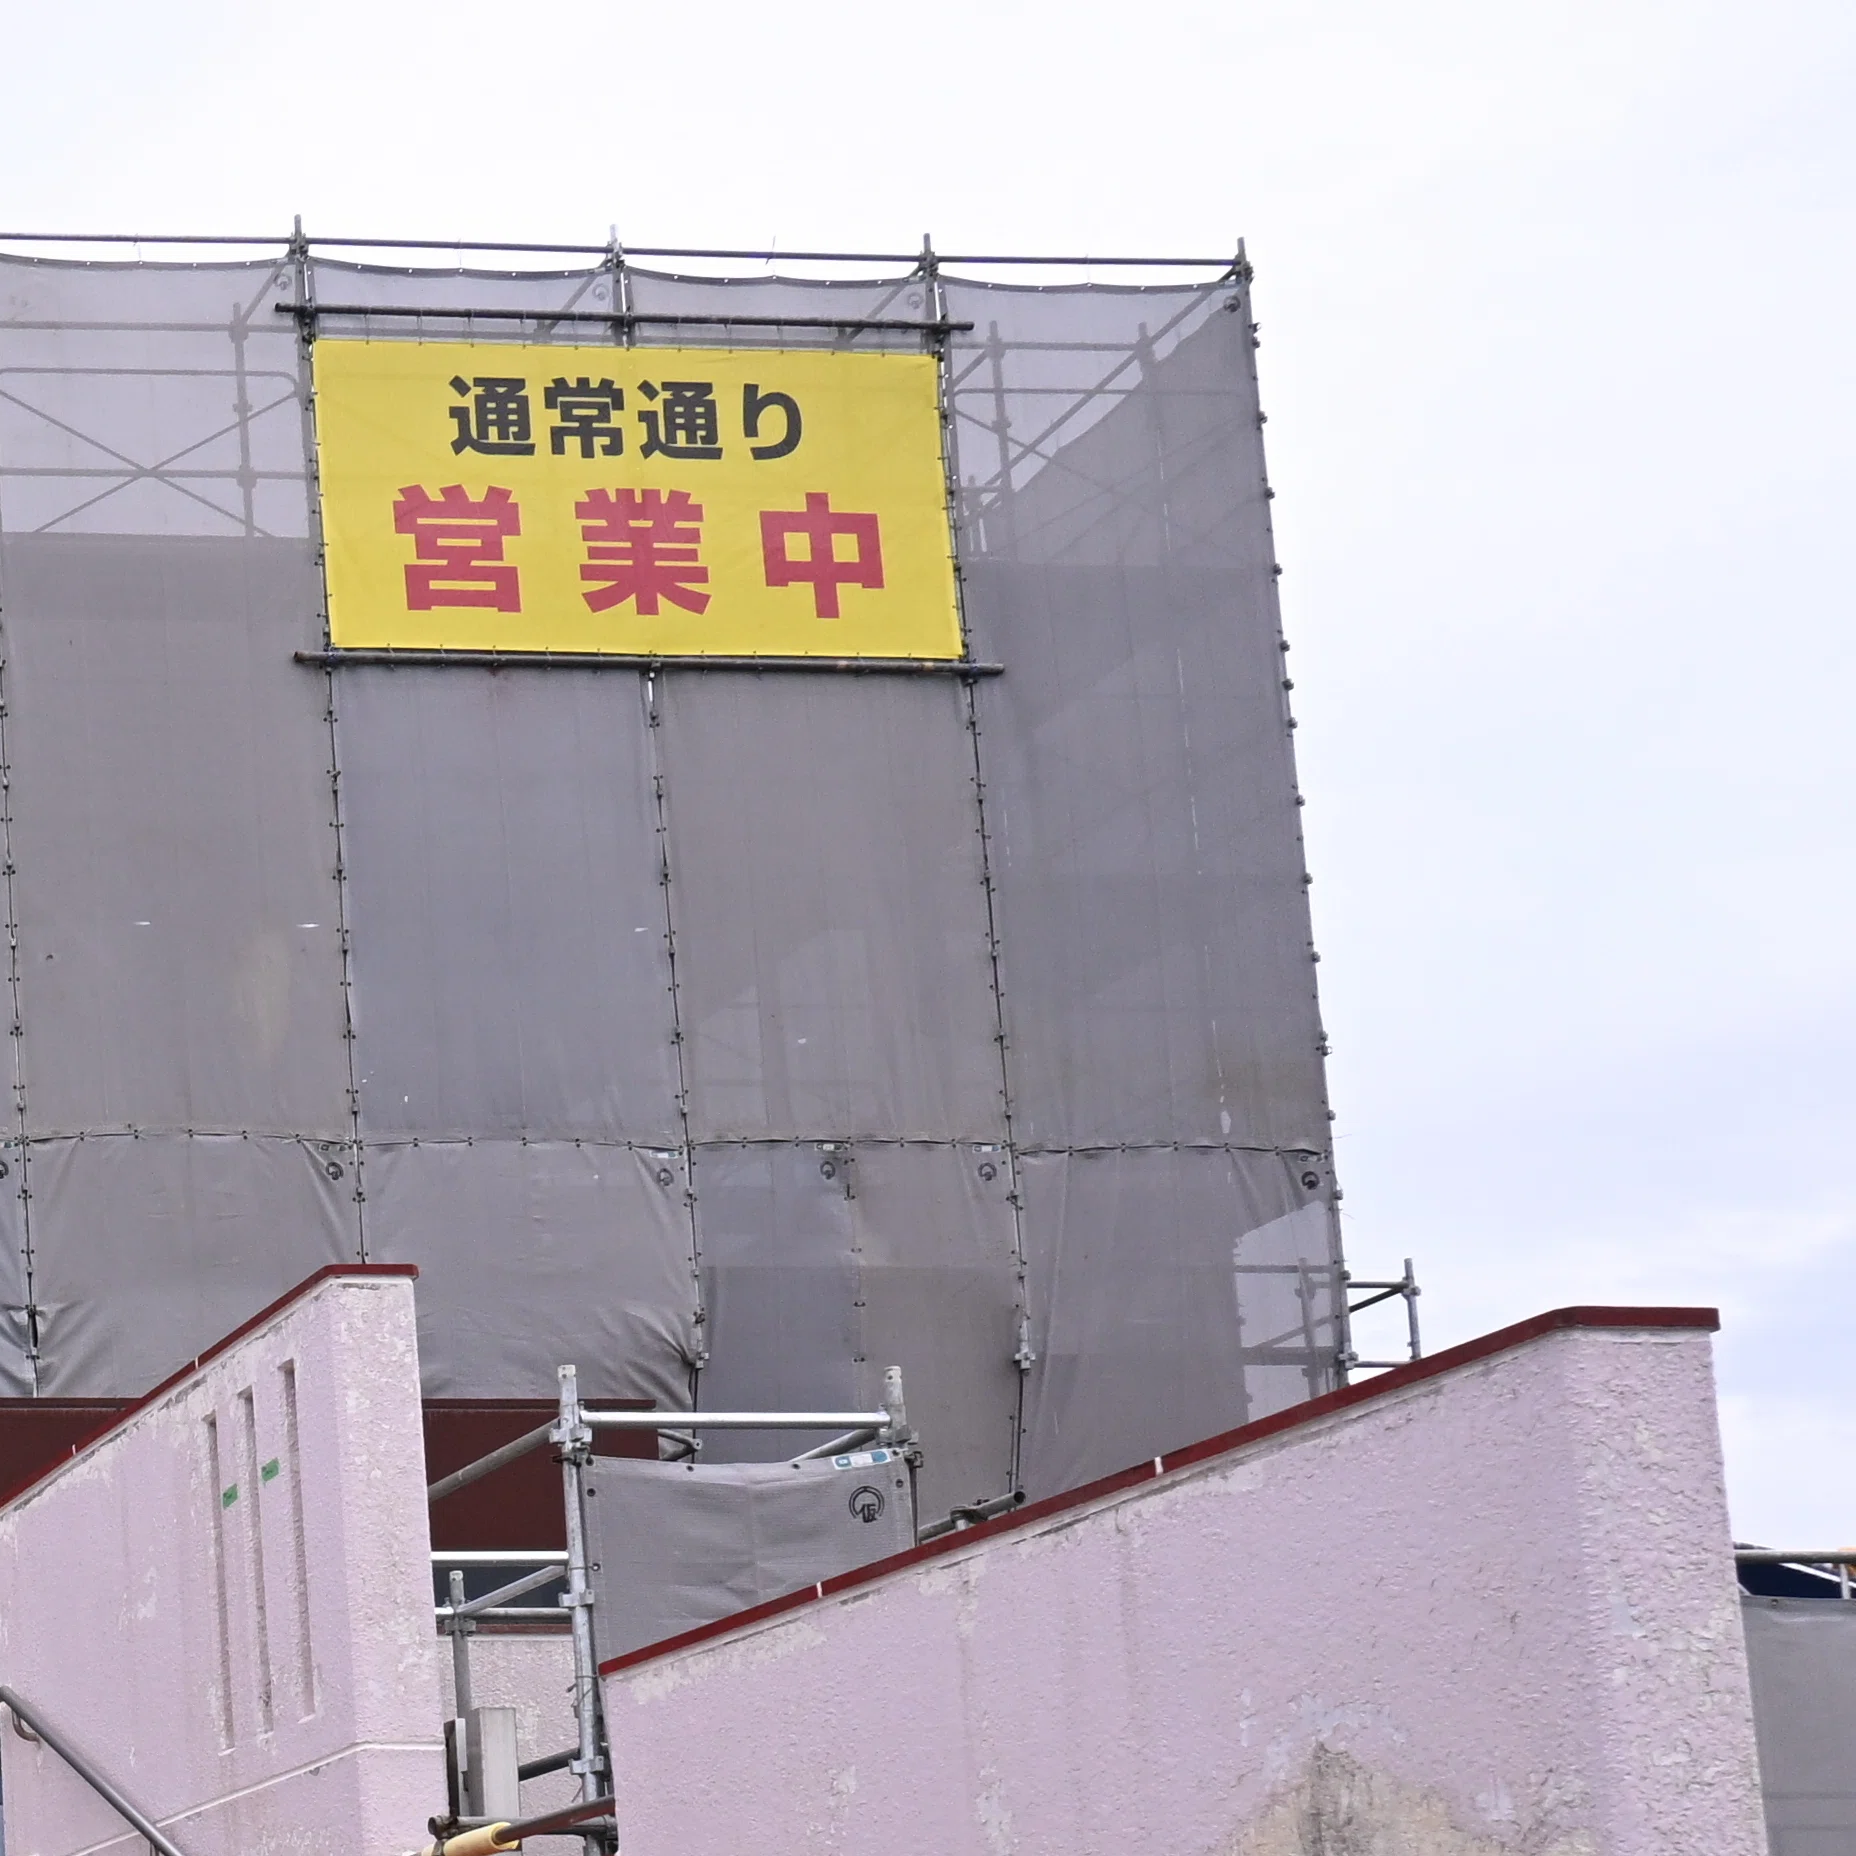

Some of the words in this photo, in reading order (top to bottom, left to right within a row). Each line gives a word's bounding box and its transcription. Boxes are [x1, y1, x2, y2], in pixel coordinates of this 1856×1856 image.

[447, 374, 803, 461] 通常通り
[392, 483, 885, 620] 営業中
